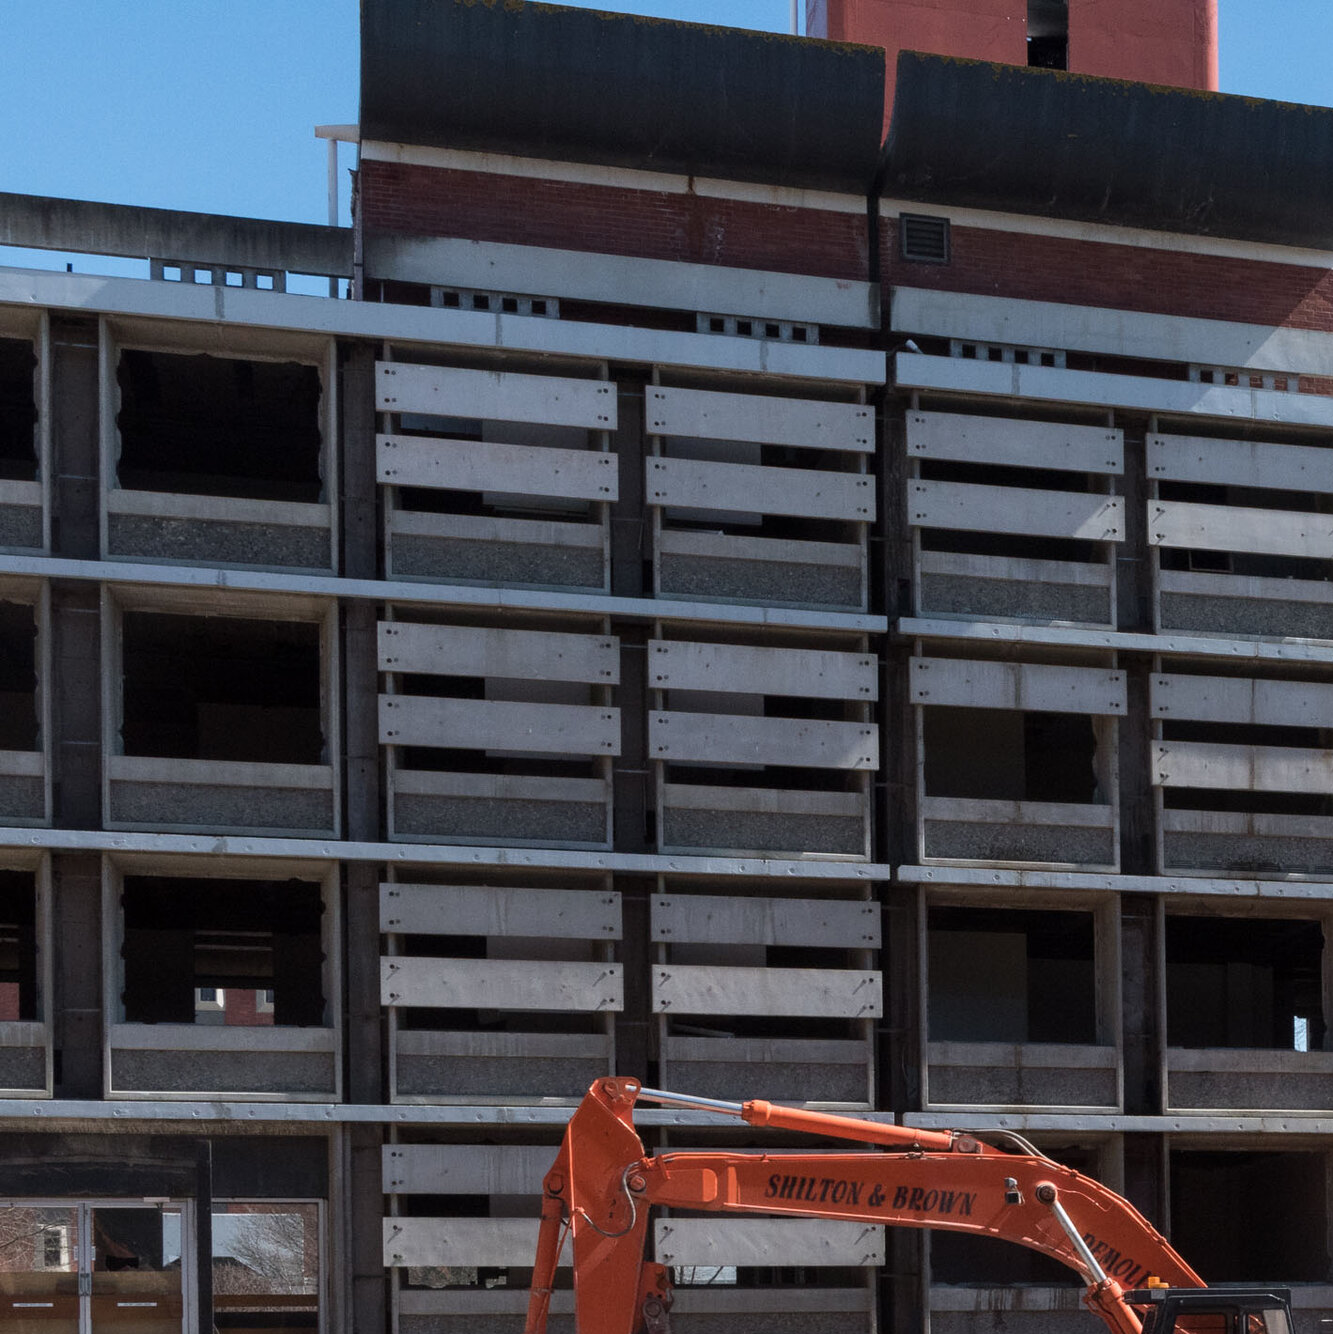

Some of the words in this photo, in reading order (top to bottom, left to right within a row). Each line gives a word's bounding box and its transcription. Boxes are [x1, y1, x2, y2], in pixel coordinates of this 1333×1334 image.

[765, 1174, 864, 1206] SHILTON
[868, 1184, 886, 1207] &
[893, 1186, 977, 1216] BROWN
